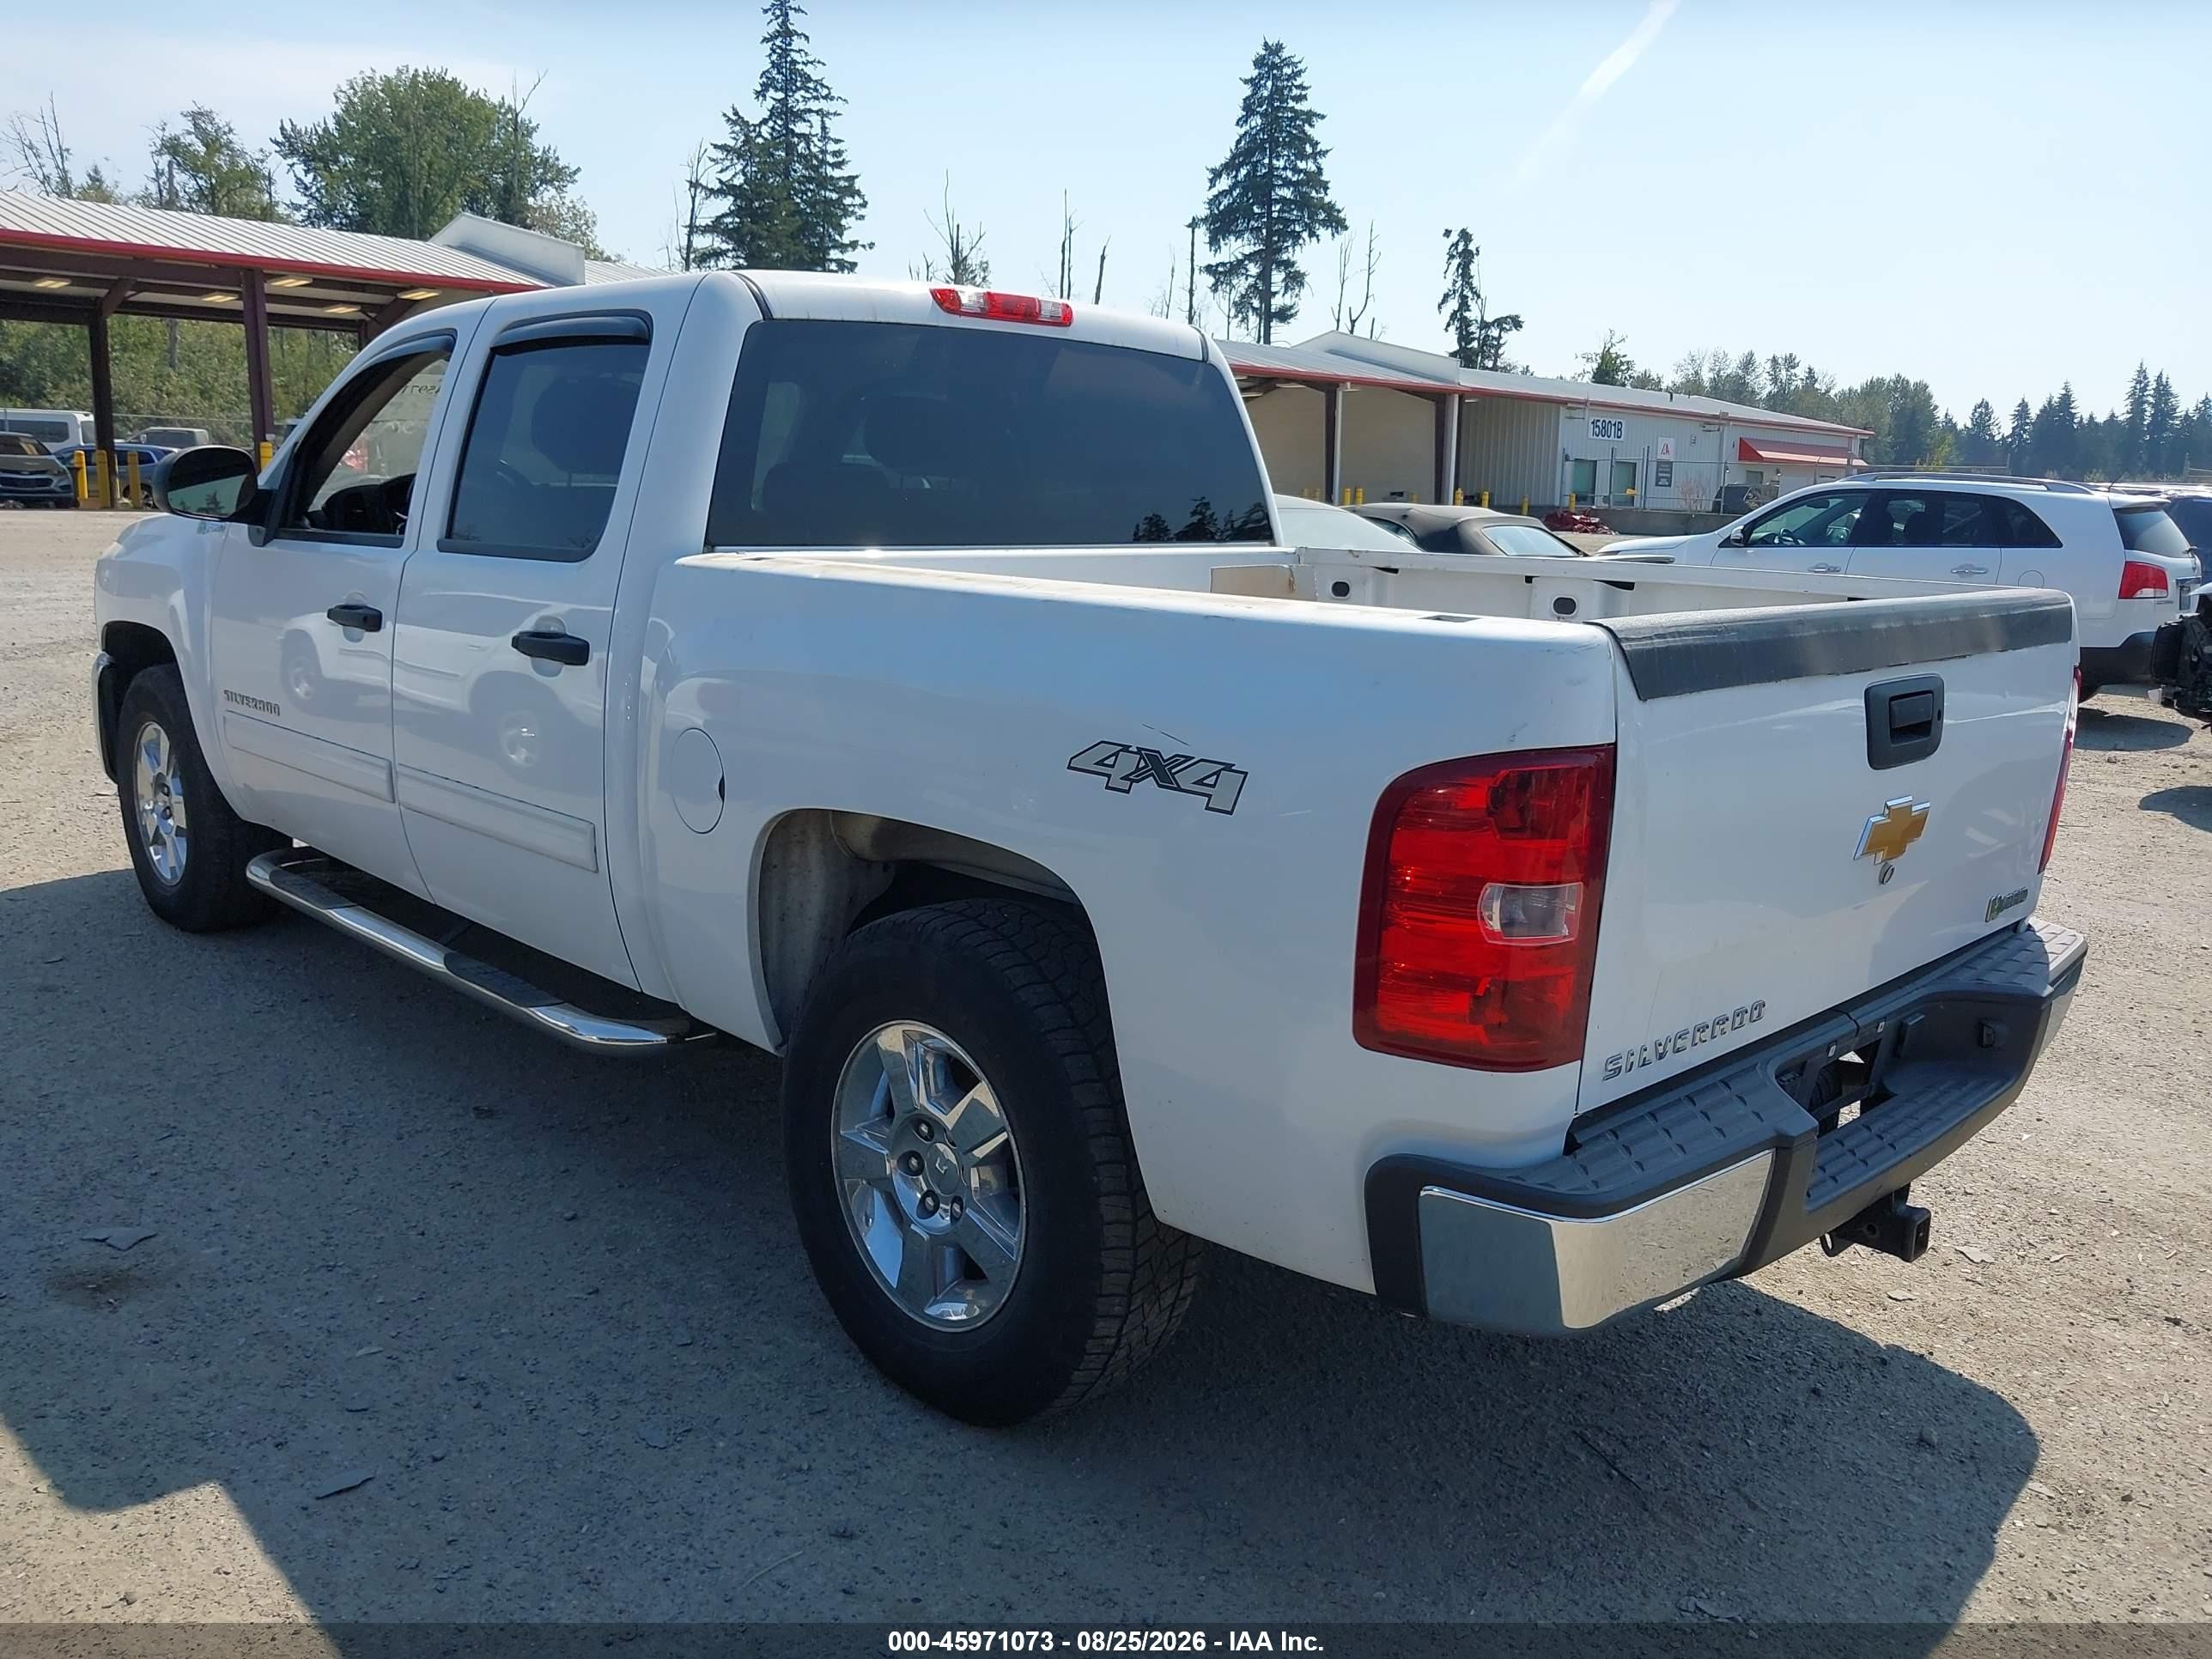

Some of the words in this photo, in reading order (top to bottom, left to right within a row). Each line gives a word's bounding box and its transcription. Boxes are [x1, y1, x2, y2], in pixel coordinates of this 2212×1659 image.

[1591, 419, 1623, 439] 15801B
[223, 690, 280, 716] SILVERADO
[1601, 999, 1766, 1081] SILVERADO
